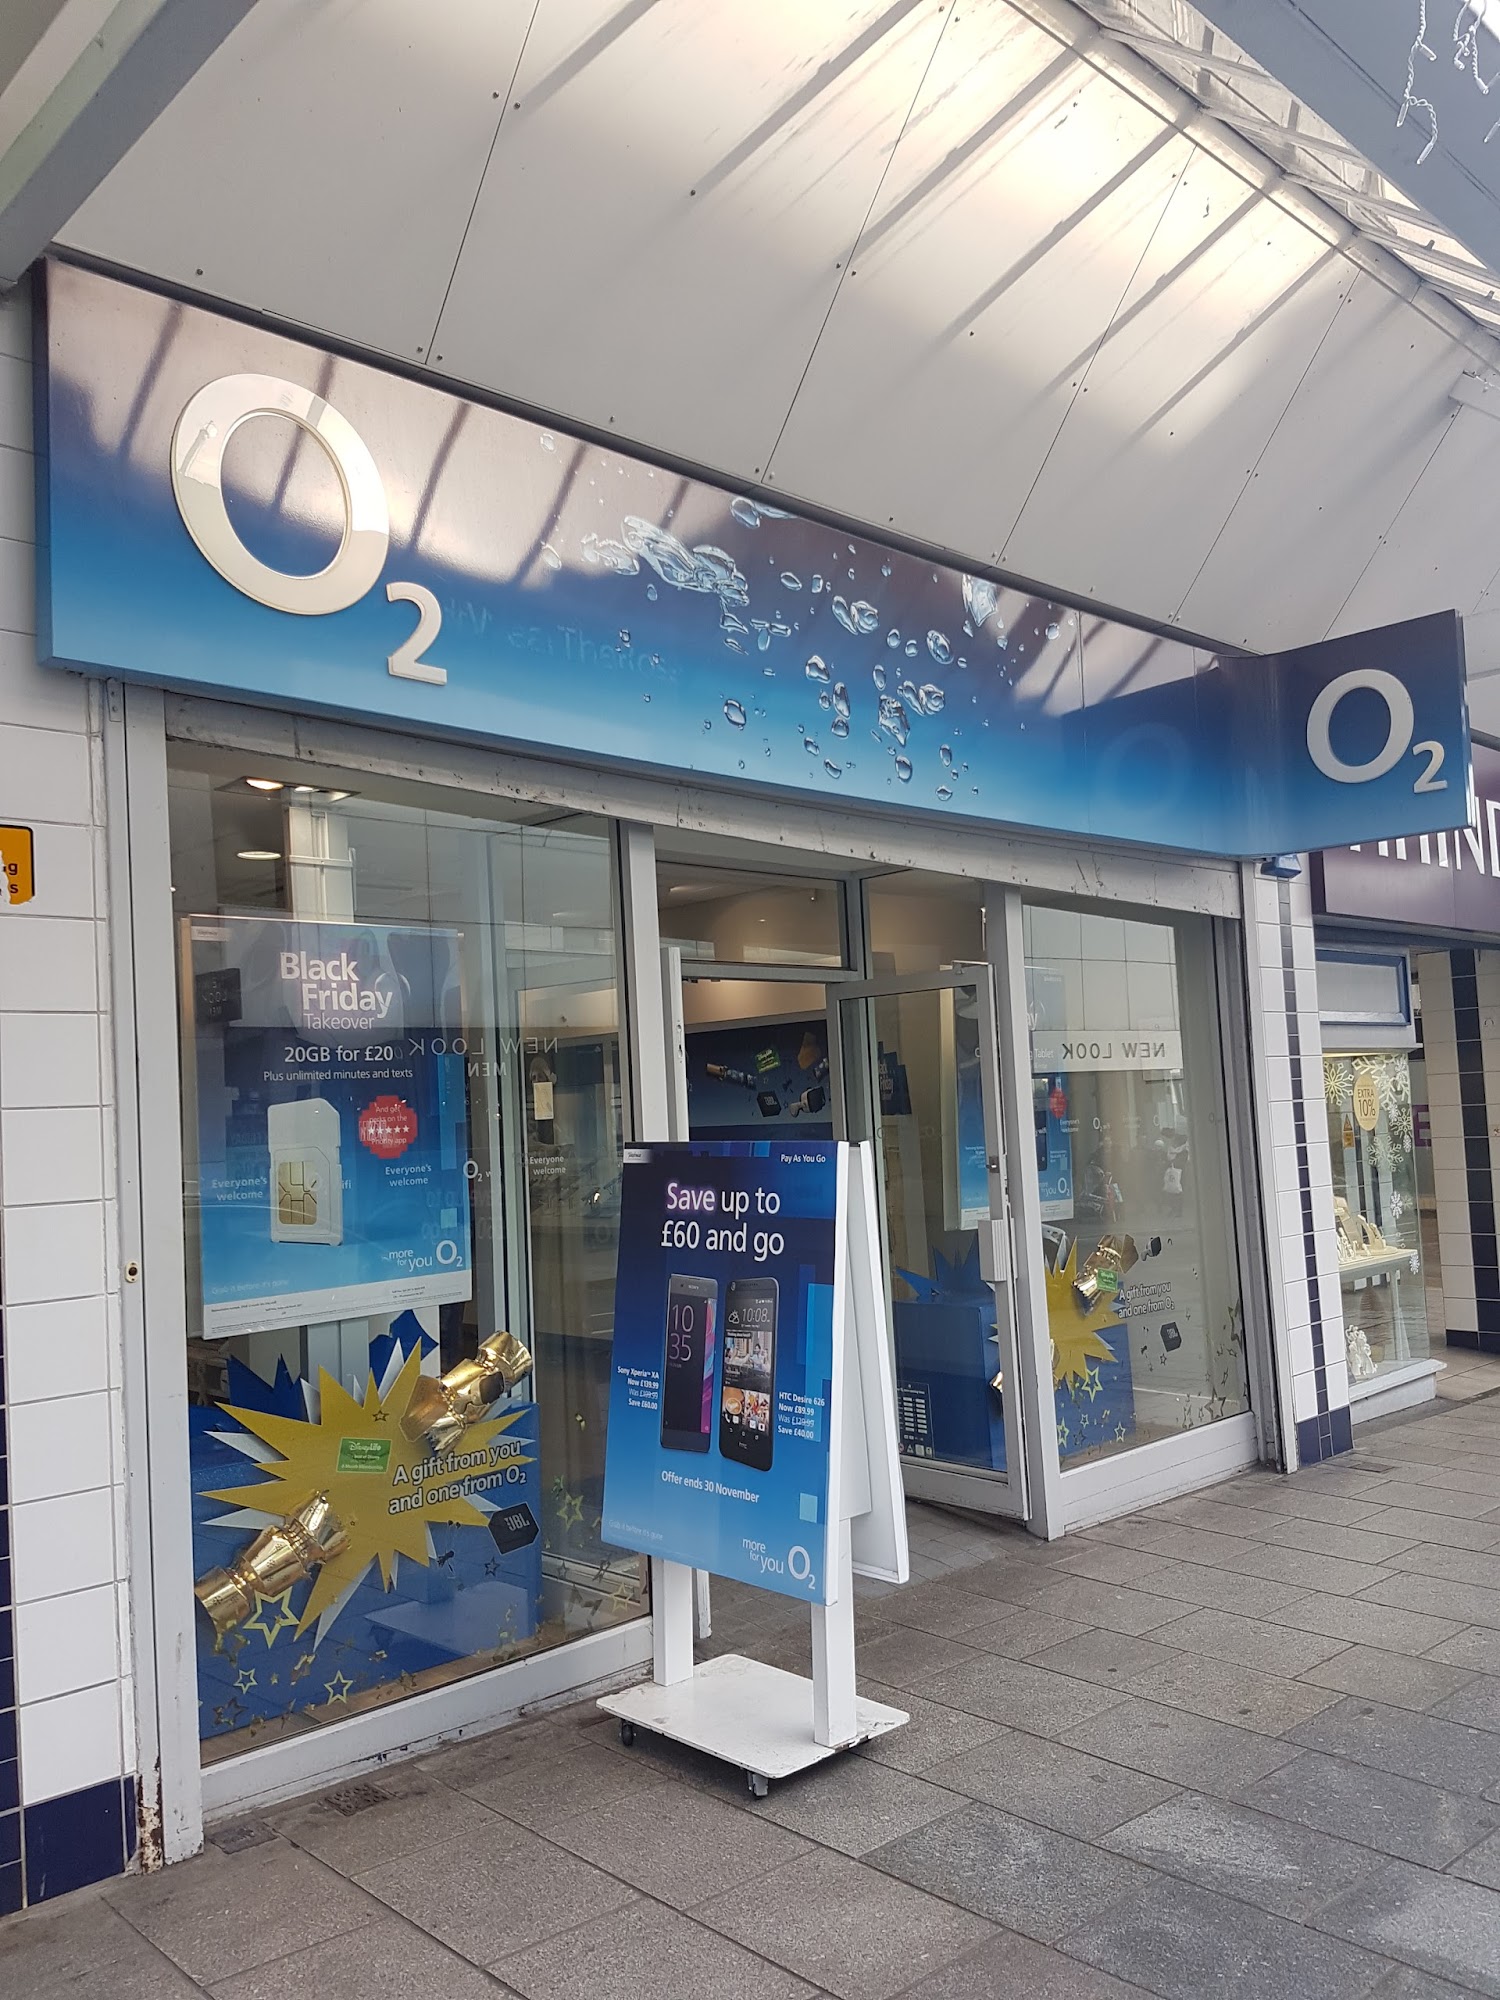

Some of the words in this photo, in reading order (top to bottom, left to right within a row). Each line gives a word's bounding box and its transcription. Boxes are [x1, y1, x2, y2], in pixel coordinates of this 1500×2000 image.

[171, 373, 447, 686] O2
[1306, 668, 1448, 794] O2
[280, 951, 359, 981] Black
[302, 983, 393, 1018] Friday
[303, 1013, 374, 1030] Takeover
[284, 1046, 331, 1063] 20GB
[335, 1045, 360, 1062] for
[364, 1045, 394, 1061] £20
[263, 1071, 284, 1081] Plus
[286, 1069, 331, 1081] unlimited
[333, 1069, 370, 1080] minutes
[372, 1068, 390, 1079] and
[391, 1068, 413, 1079] texts
[1357, 1089, 1374, 1099] EXTRA
[1358, 1099, 1376, 1117] 10%
[781, 1154, 792, 1164] Pay
[793, 1154, 801, 1162] As
[802, 1155, 815, 1163] You
[816, 1155, 826, 1163] Go
[385, 1164, 432, 1177] Everyone's
[533, 1167, 566, 1176] welcome
[212, 1176, 268, 1188] Everyone's
[389, 1177, 429, 1187] welcome
[217, 1191, 263, 1201] welcome
[666, 1182, 715, 1211] Save
[721, 1190, 749, 1219] up
[755, 1187, 781, 1214] to
[661, 1220, 700, 1249] £60
[706, 1223, 747, 1252] and
[754, 1231, 784, 1262] go
[389, 1249, 414, 1260] more
[408, 1256, 433, 1272] you
[1119, 1289, 1126, 1301] A
[1126, 1286, 1140, 1302] gift
[1140, 1283, 1157, 1298] from
[1157, 1282, 1171, 1297] you
[742, 1308, 768, 1322] 10:08
[1119, 1306, 1132, 1319] and
[1134, 1304, 1147, 1316] one
[1148, 1300, 1164, 1314] from
[672, 1304, 694, 1332] 10
[669, 1333, 692, 1361] 35
[617, 1366, 630, 1376] Sony
[651, 1371, 659, 1380] XA
[628, 1378, 639, 1386] Now
[629, 1398, 640, 1407] Save
[779, 1391, 792, 1401] HTC
[793, 1394, 812, 1404] Desire
[813, 1397, 825, 1406] 626
[778, 1403, 793, 1412] Now
[794, 1405, 815, 1416] £89.99
[778, 1414, 790, 1423] Was
[778, 1425, 792, 1435] Save
[794, 1428, 813, 1439] £40.00
[393, 1467, 408, 1486] A
[411, 1458, 444, 1485] gift
[447, 1450, 486, 1473] from
[491, 1441, 521, 1467] you
[389, 1487, 423, 1514] and
[426, 1484, 459, 1507] one
[462, 1472, 502, 1496] from
[661, 1470, 683, 1484] Offer
[684, 1477, 703, 1490] ends
[704, 1480, 714, 1492] 30
[716, 1483, 759, 1503] November
[504, 1513, 530, 1531] JBL
[743, 1538, 766, 1553] more
[750, 1550, 759, 1561] for
[760, 1555, 784, 1574] you
